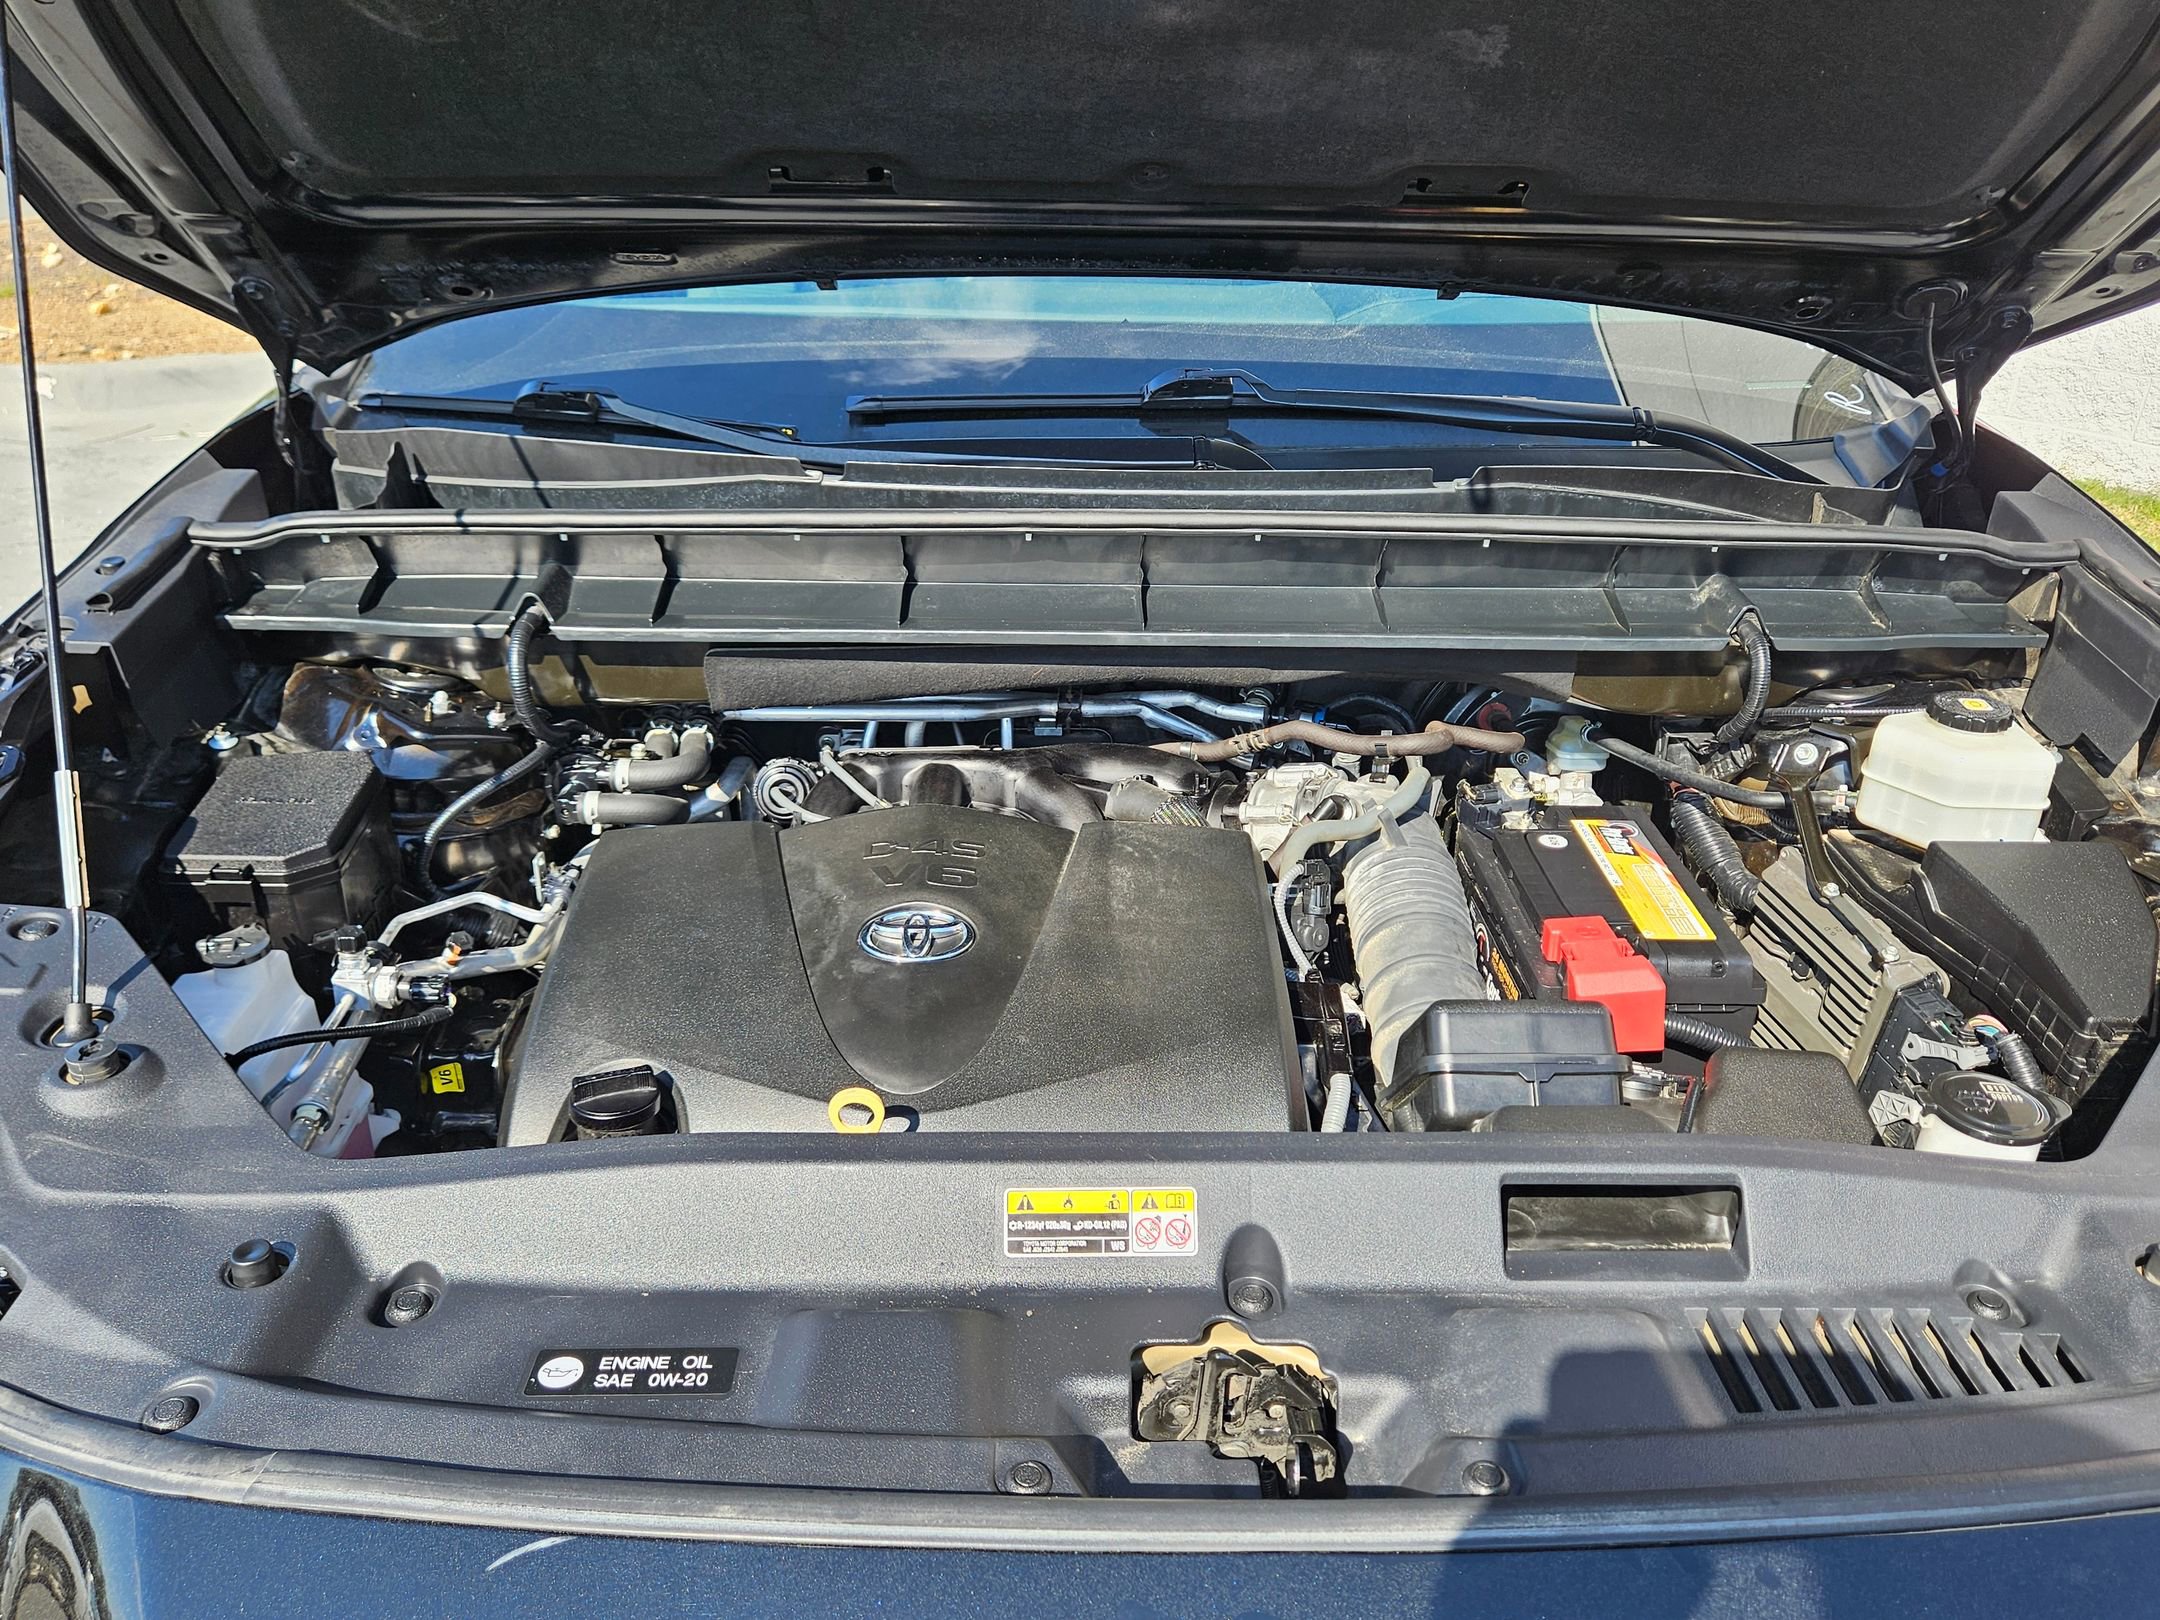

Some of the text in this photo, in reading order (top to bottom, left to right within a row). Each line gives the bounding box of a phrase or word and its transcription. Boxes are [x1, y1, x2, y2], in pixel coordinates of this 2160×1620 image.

[863, 838, 986, 860] D-4S
[869, 862, 978, 889] V6
[439, 1069, 453, 1086] V6
[598, 1355, 713, 1370] ENGINE OIL
[593, 1373, 709, 1388] SAE 0W-20
